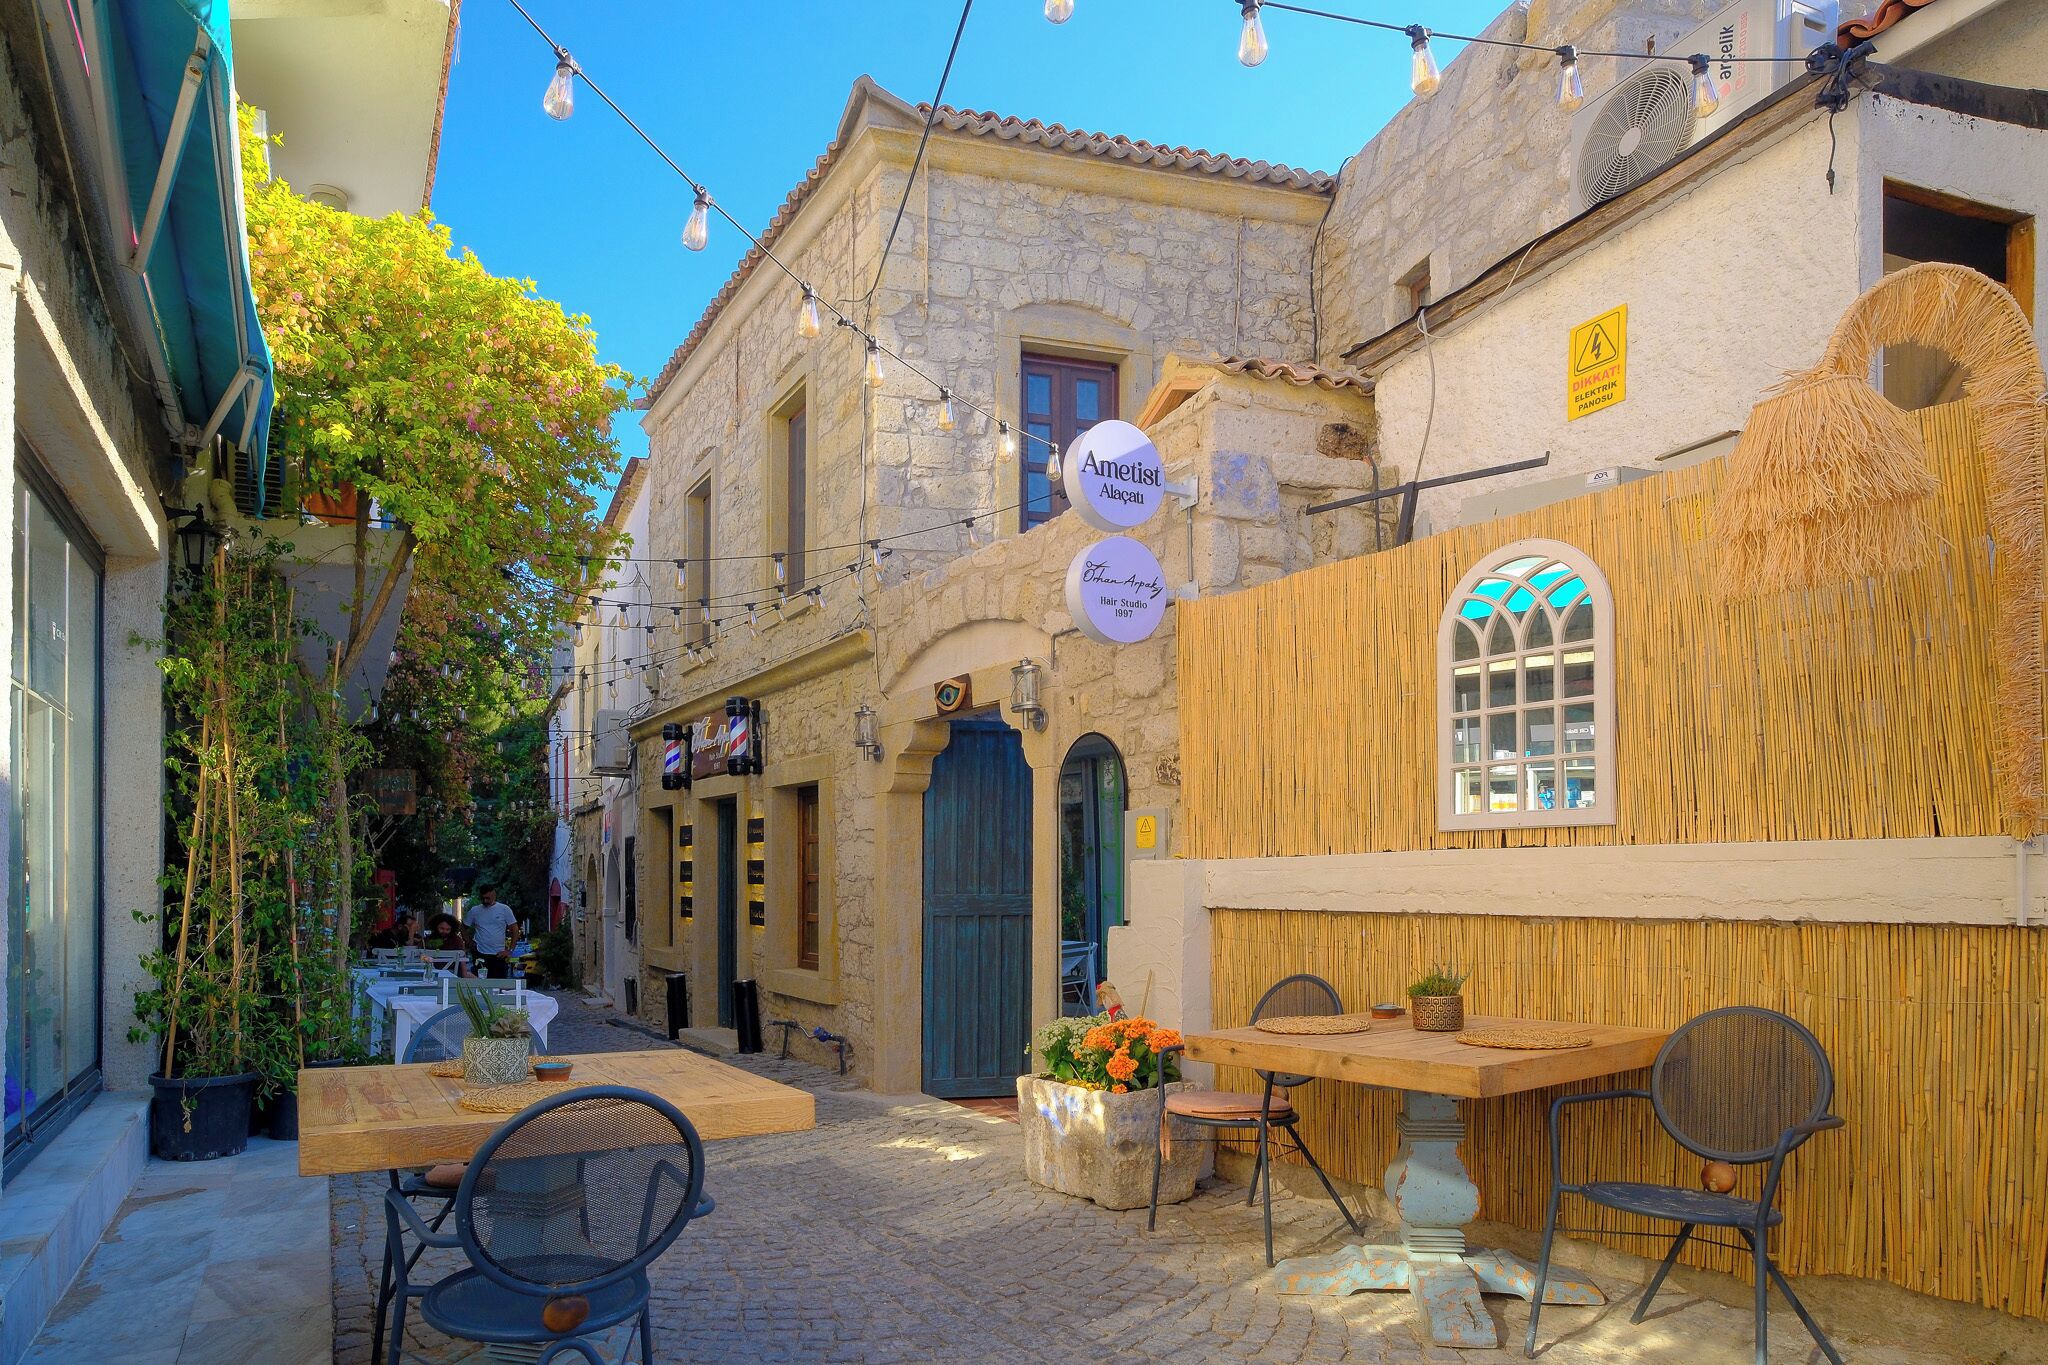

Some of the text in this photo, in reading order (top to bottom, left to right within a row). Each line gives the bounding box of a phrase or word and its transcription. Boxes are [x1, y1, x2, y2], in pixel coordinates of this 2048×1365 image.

[1719, 24, 1735, 80] arçelik
[1573, 364, 1620, 392] DİKKAT!
[1578, 392, 1614, 412] PANOSU
[1081, 450, 1162, 487] Ametist
[1099, 483, 1144, 505] Alaçatı
[1083, 564, 1122, 584] Orhan
[1100, 596, 1148, 609] Hair Studio
[1115, 608, 1133, 618] 1997
